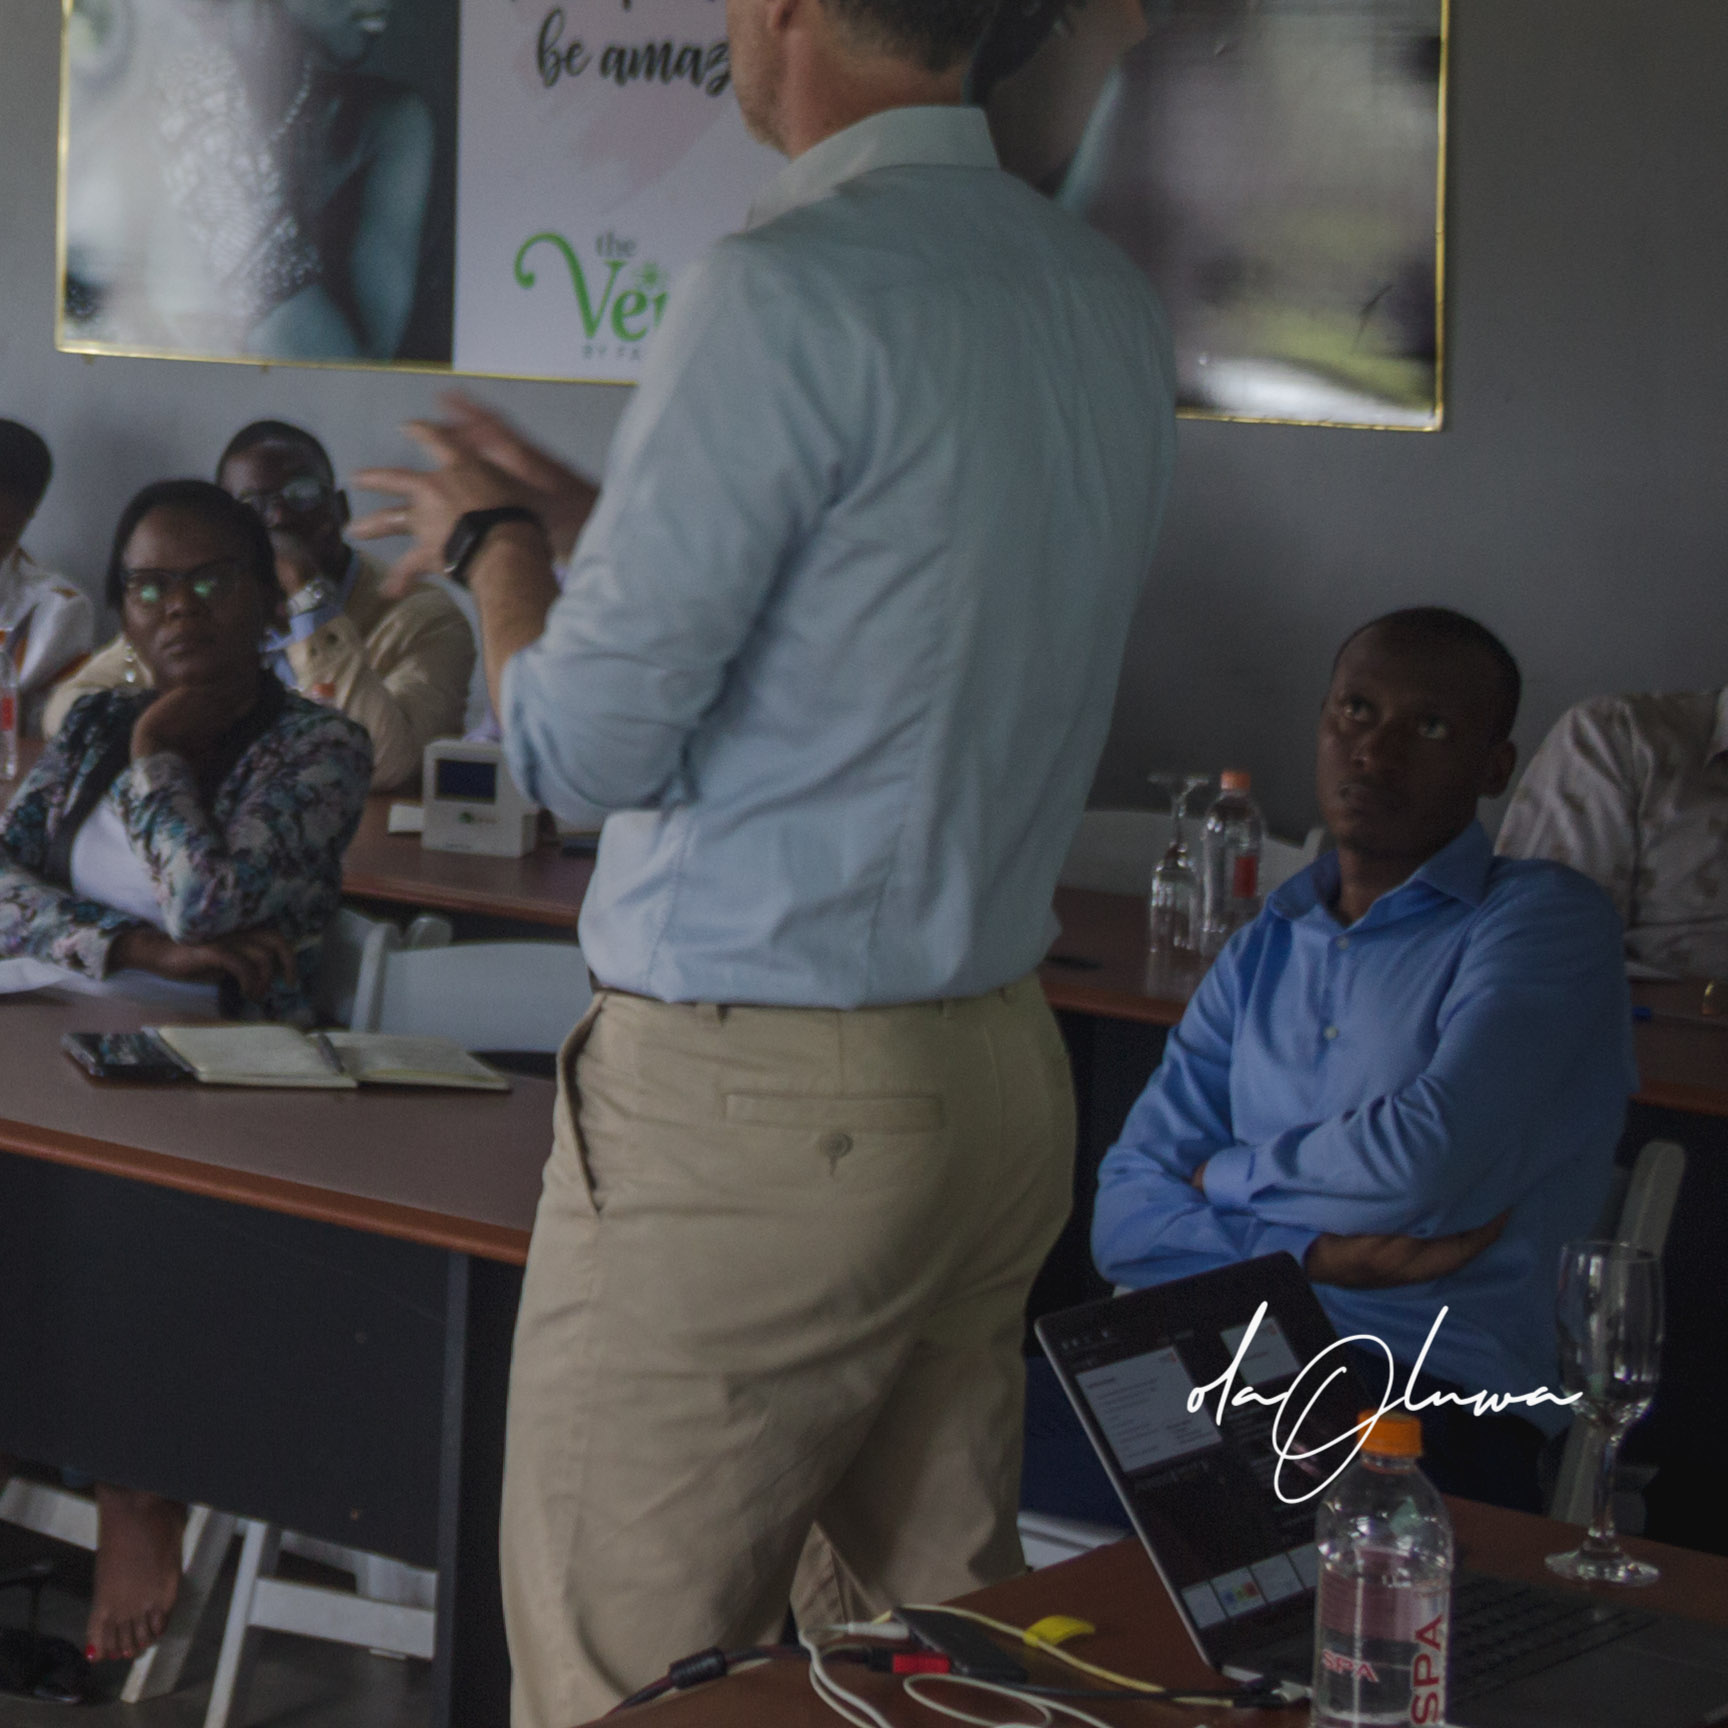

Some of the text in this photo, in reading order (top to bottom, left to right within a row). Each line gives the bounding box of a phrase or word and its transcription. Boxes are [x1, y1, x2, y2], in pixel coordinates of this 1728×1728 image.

[537, 6, 732, 98] be amaz
[596, 229, 636, 257] the
[1321, 1648, 1380, 1684] SPA
[1409, 1613, 1444, 1726] SPA
